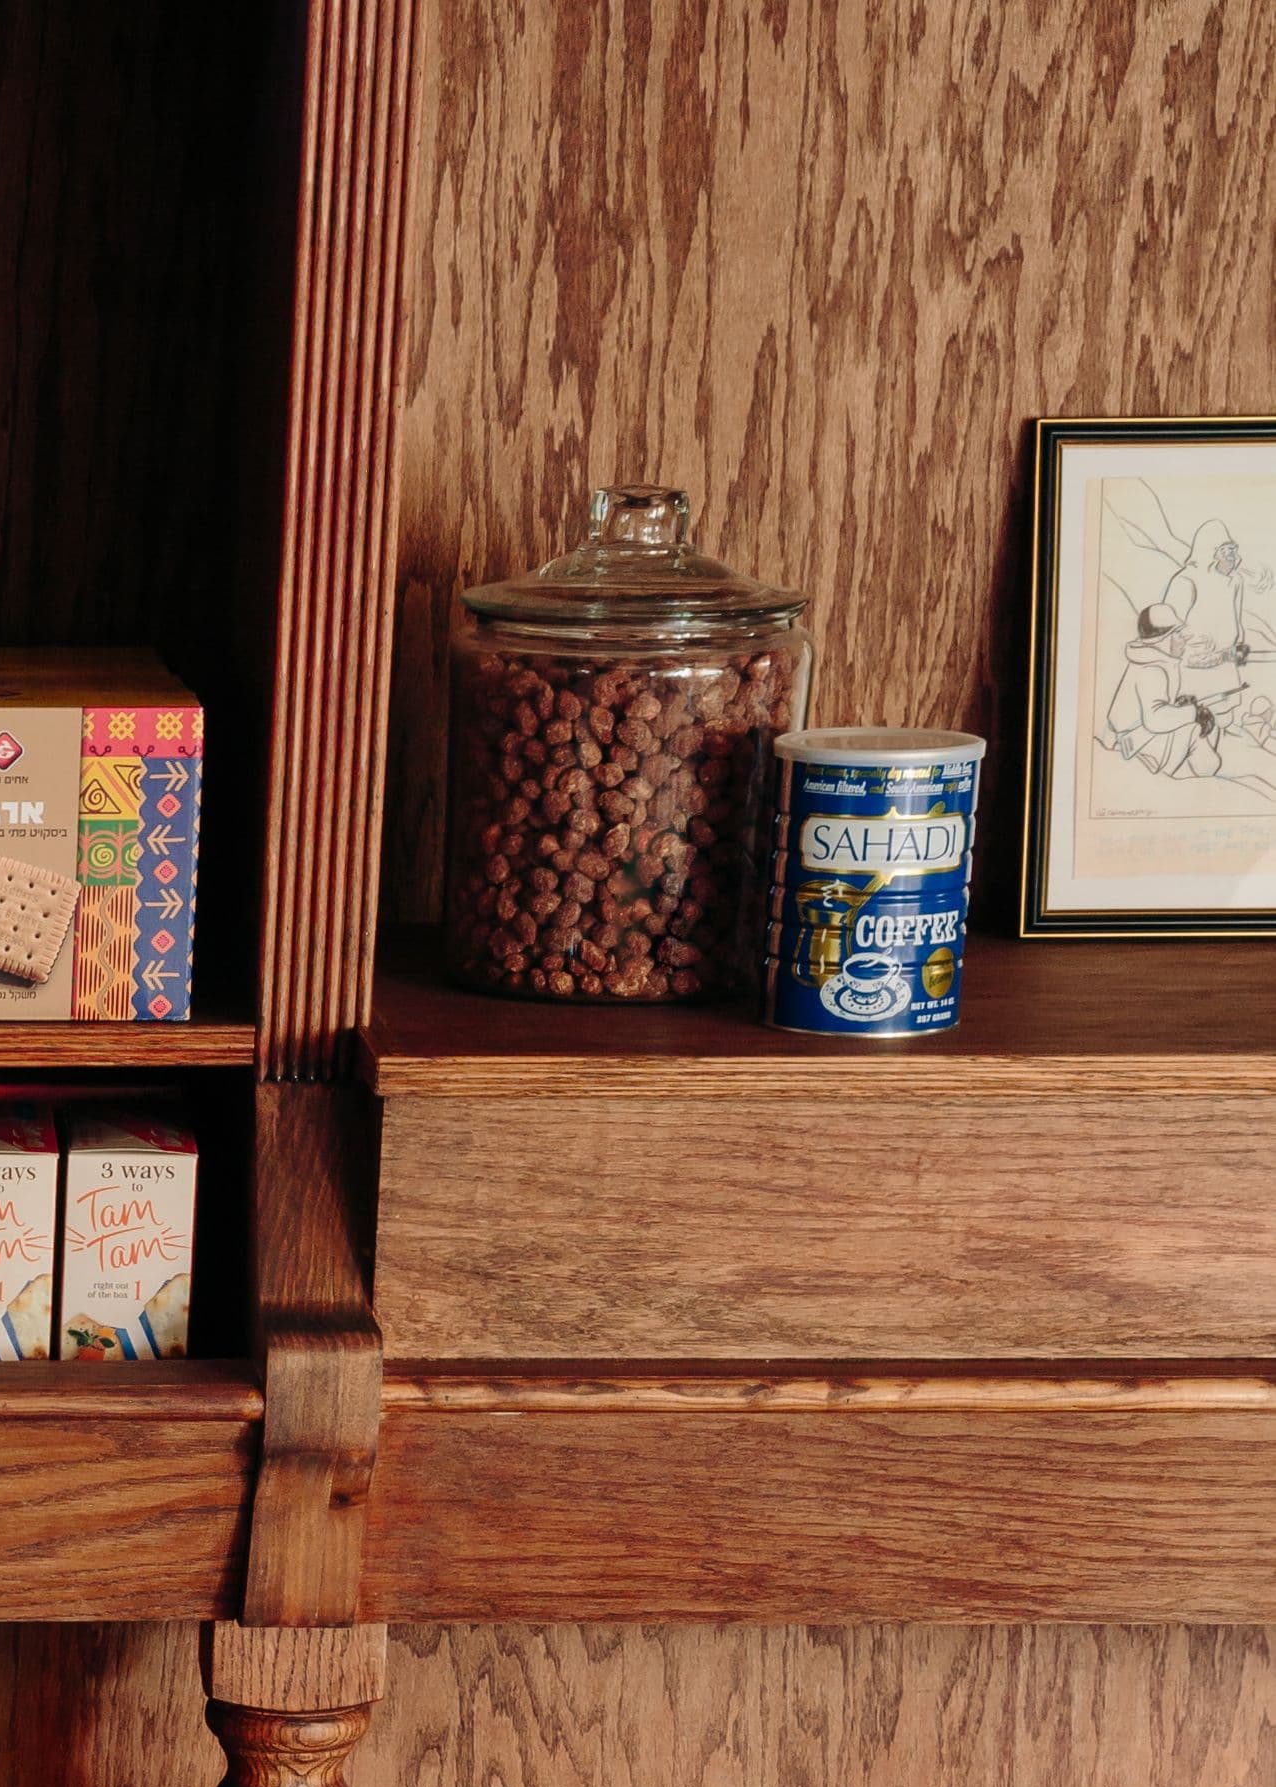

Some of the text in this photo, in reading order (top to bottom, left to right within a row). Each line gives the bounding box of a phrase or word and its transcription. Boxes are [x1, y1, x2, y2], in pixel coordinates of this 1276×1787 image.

[4, 776, 29, 785] אחים
[8, 829, 27, 838] פתי
[29, 829, 68, 840] ביסקויט
[812, 824, 957, 862] SAHADI
[856, 910, 959, 948] COFFEE
[9, 990, 37, 1002] משקל
[101, 1162, 175, 1183] 3 ways
[131, 1183, 143, 1192] to
[76, 1186, 164, 1232] Tam
[86, 1226, 179, 1272] Tam
[93, 1282, 114, 1292] right
[134, 1280, 142, 1301] 1
[87, 1290, 129, 1299] of the box
